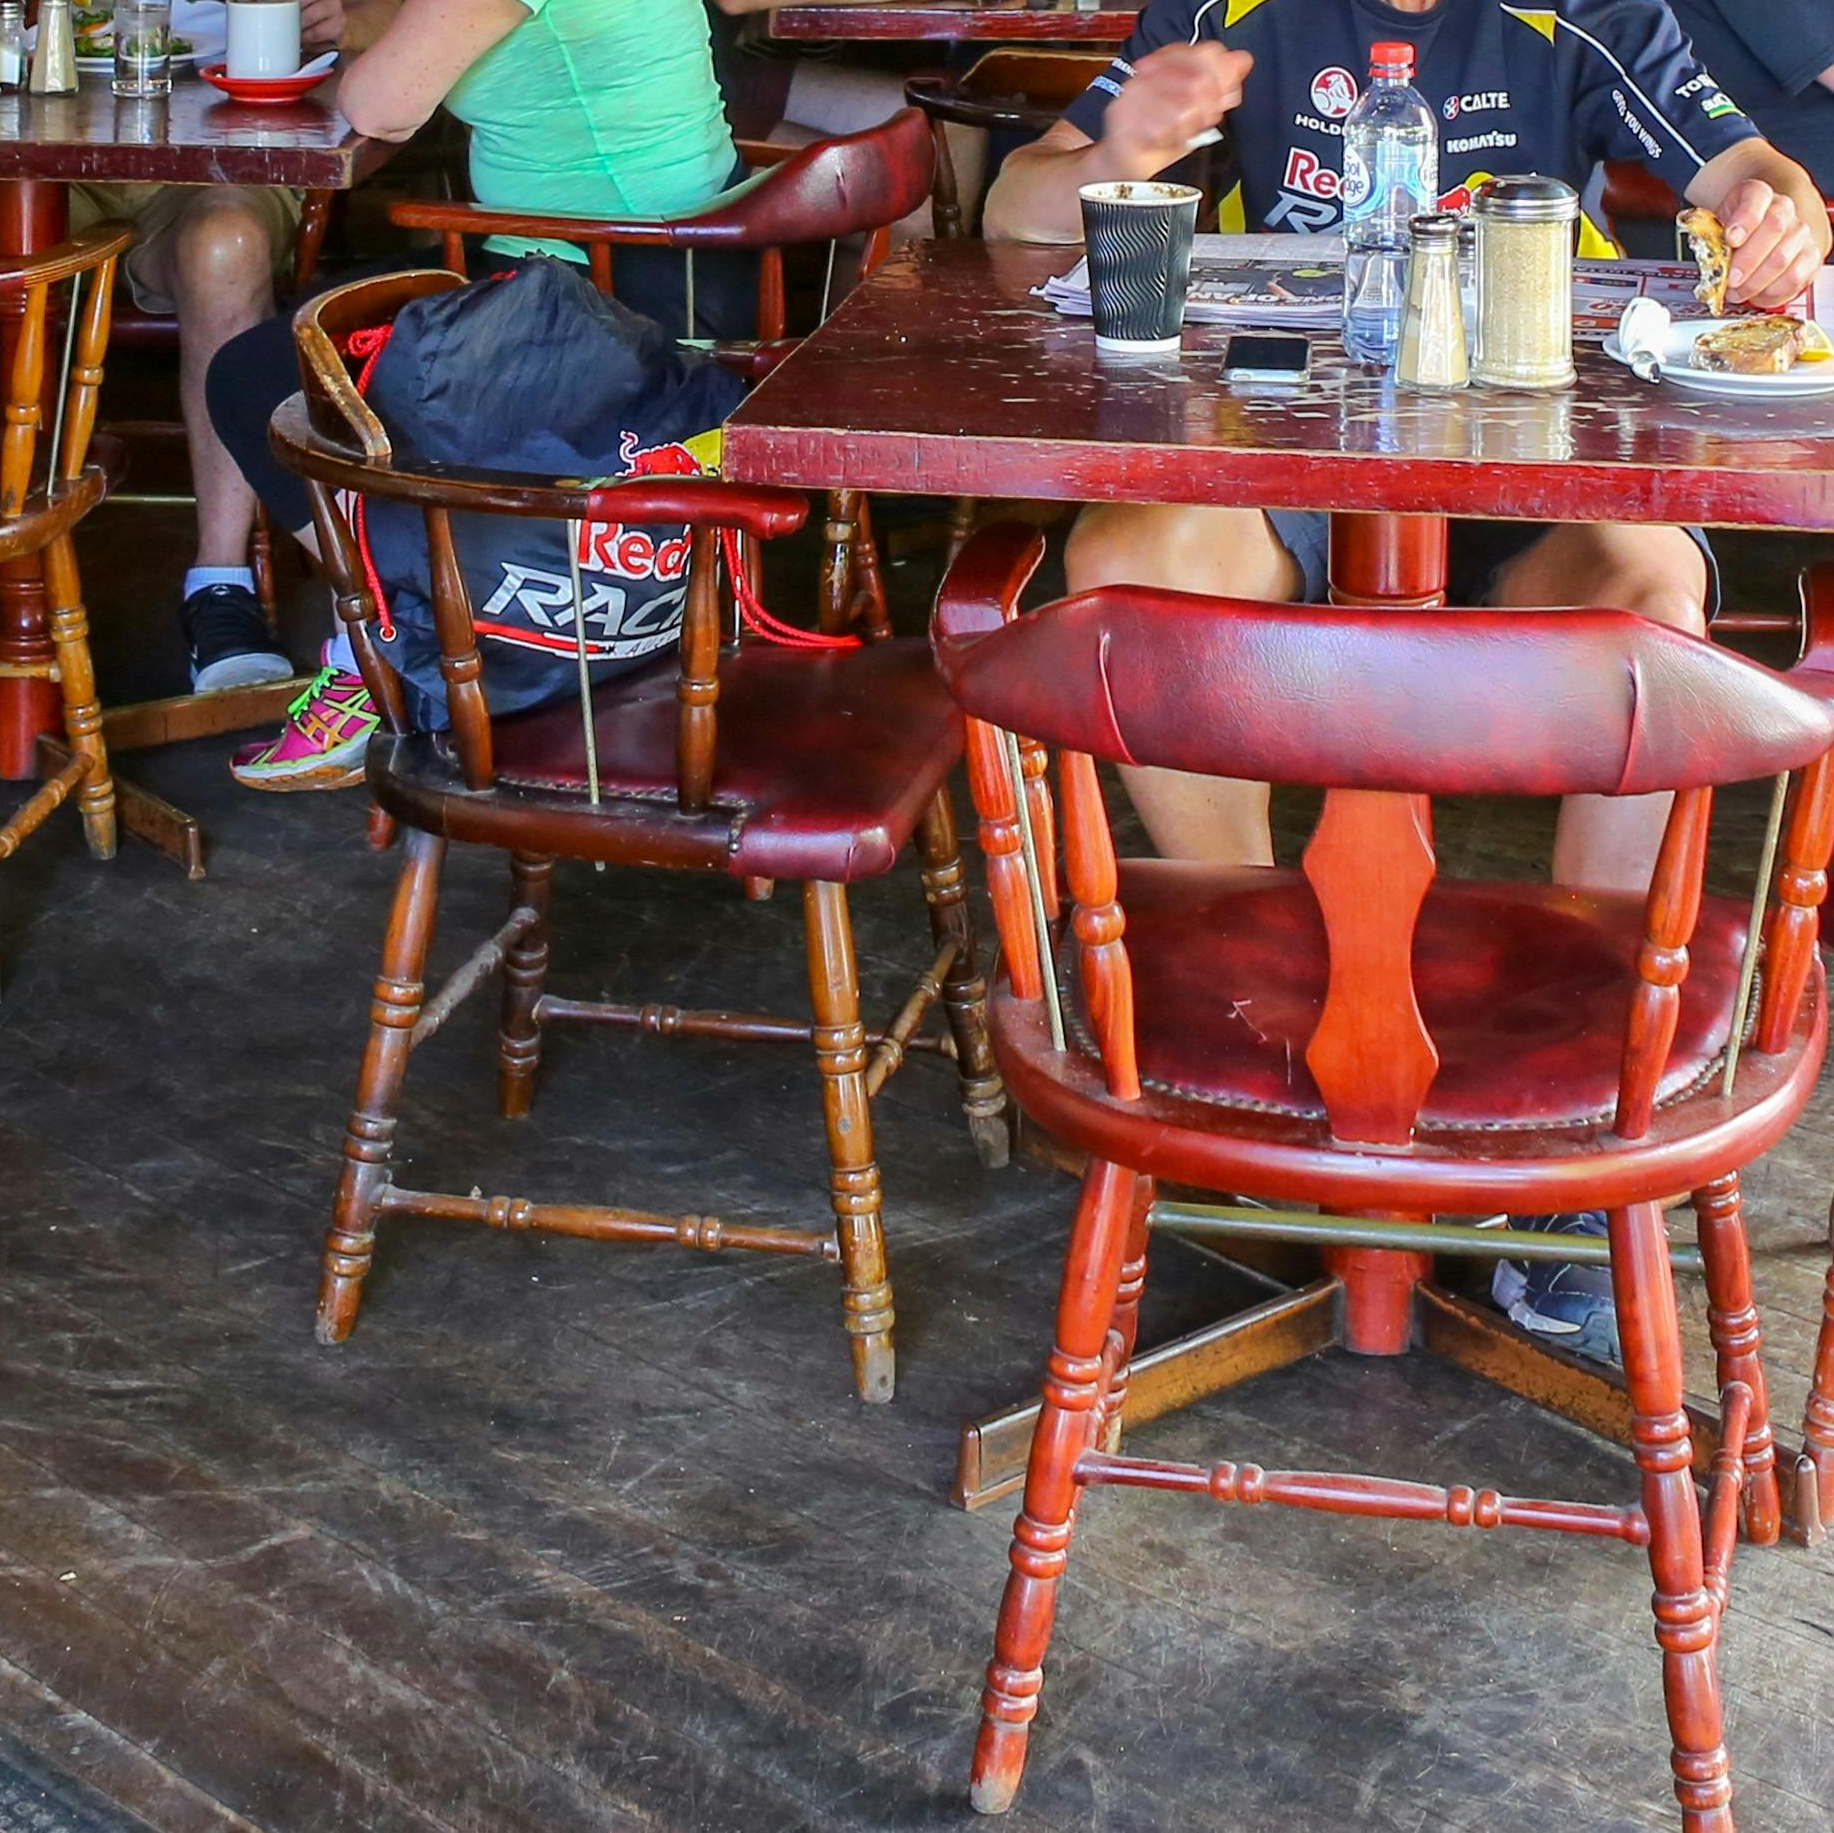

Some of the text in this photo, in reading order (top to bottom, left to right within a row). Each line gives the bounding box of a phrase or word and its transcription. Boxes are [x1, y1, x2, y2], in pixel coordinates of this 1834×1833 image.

[1446, 131, 1517, 155] KOMATSU
[1611, 89, 1664, 159] GIVES YOU WINGS
